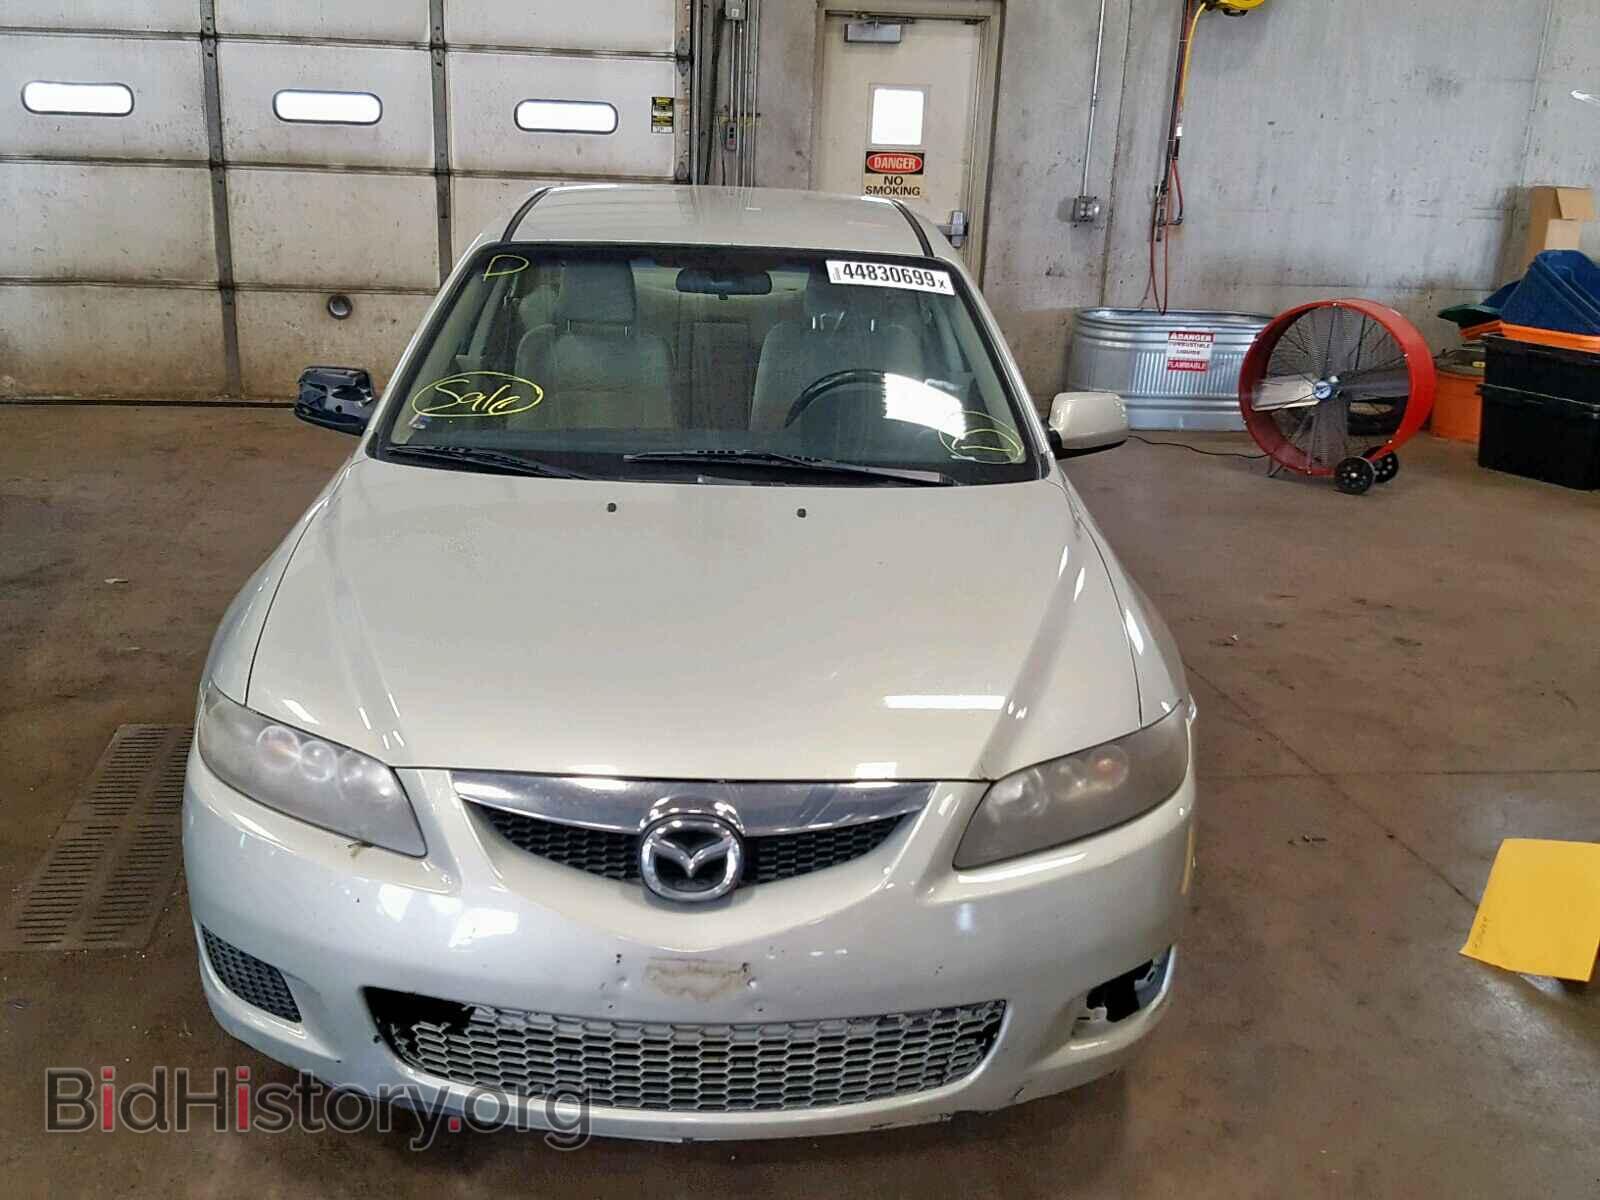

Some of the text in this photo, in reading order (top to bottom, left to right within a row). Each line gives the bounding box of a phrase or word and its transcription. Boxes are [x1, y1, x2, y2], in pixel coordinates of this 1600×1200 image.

[874, 156, 916, 169] DANGER
[883, 175, 904, 186] NO
[865, 185, 921, 196] SMOKING
[843, 263, 936, 288] 44830699
[1178, 333, 1212, 342] DANGER
